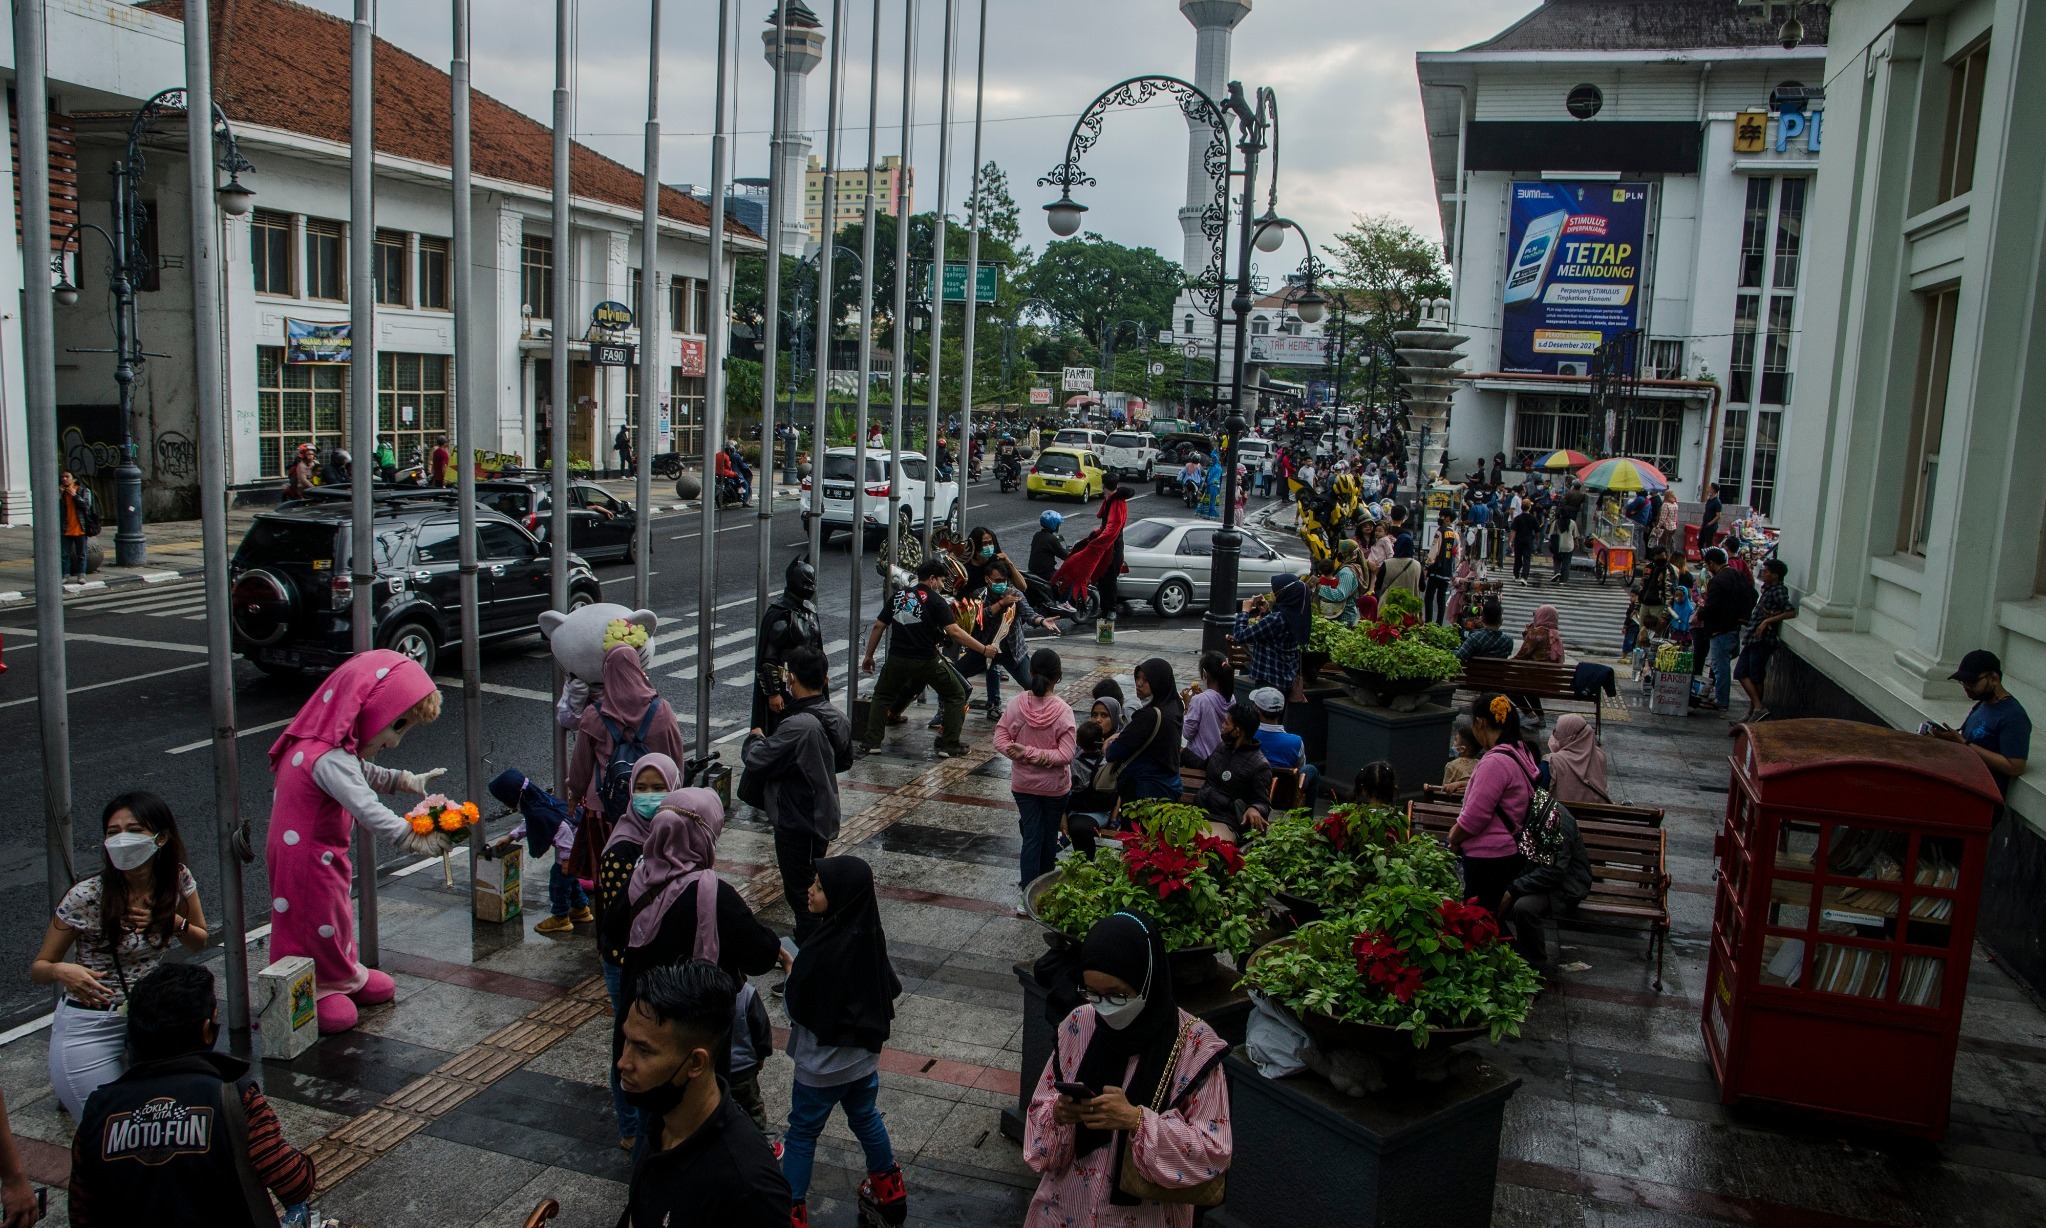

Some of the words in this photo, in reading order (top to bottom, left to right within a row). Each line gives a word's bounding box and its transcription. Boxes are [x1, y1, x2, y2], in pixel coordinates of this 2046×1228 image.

[1625, 192, 1643, 200] PLN
[1569, 217, 1606, 227] STIMULUS
[1566, 225, 1607, 235] DIPERPANJANG
[1524, 246, 1538, 255] PLN
[1565, 242, 1632, 264] TETAP
[1557, 265, 1635, 278] MELINDUNGI
[1548, 341, 1579, 349] Desember
[603, 349, 624, 361] FA90
[1065, 368, 1094, 380] PARKIR
[1660, 673, 1687, 684] BAKSO
[142, 1101, 176, 1114] COKLAT
[153, 1110, 172, 1120] KITA
[107, 1115, 206, 1153] MOTO-FUN
